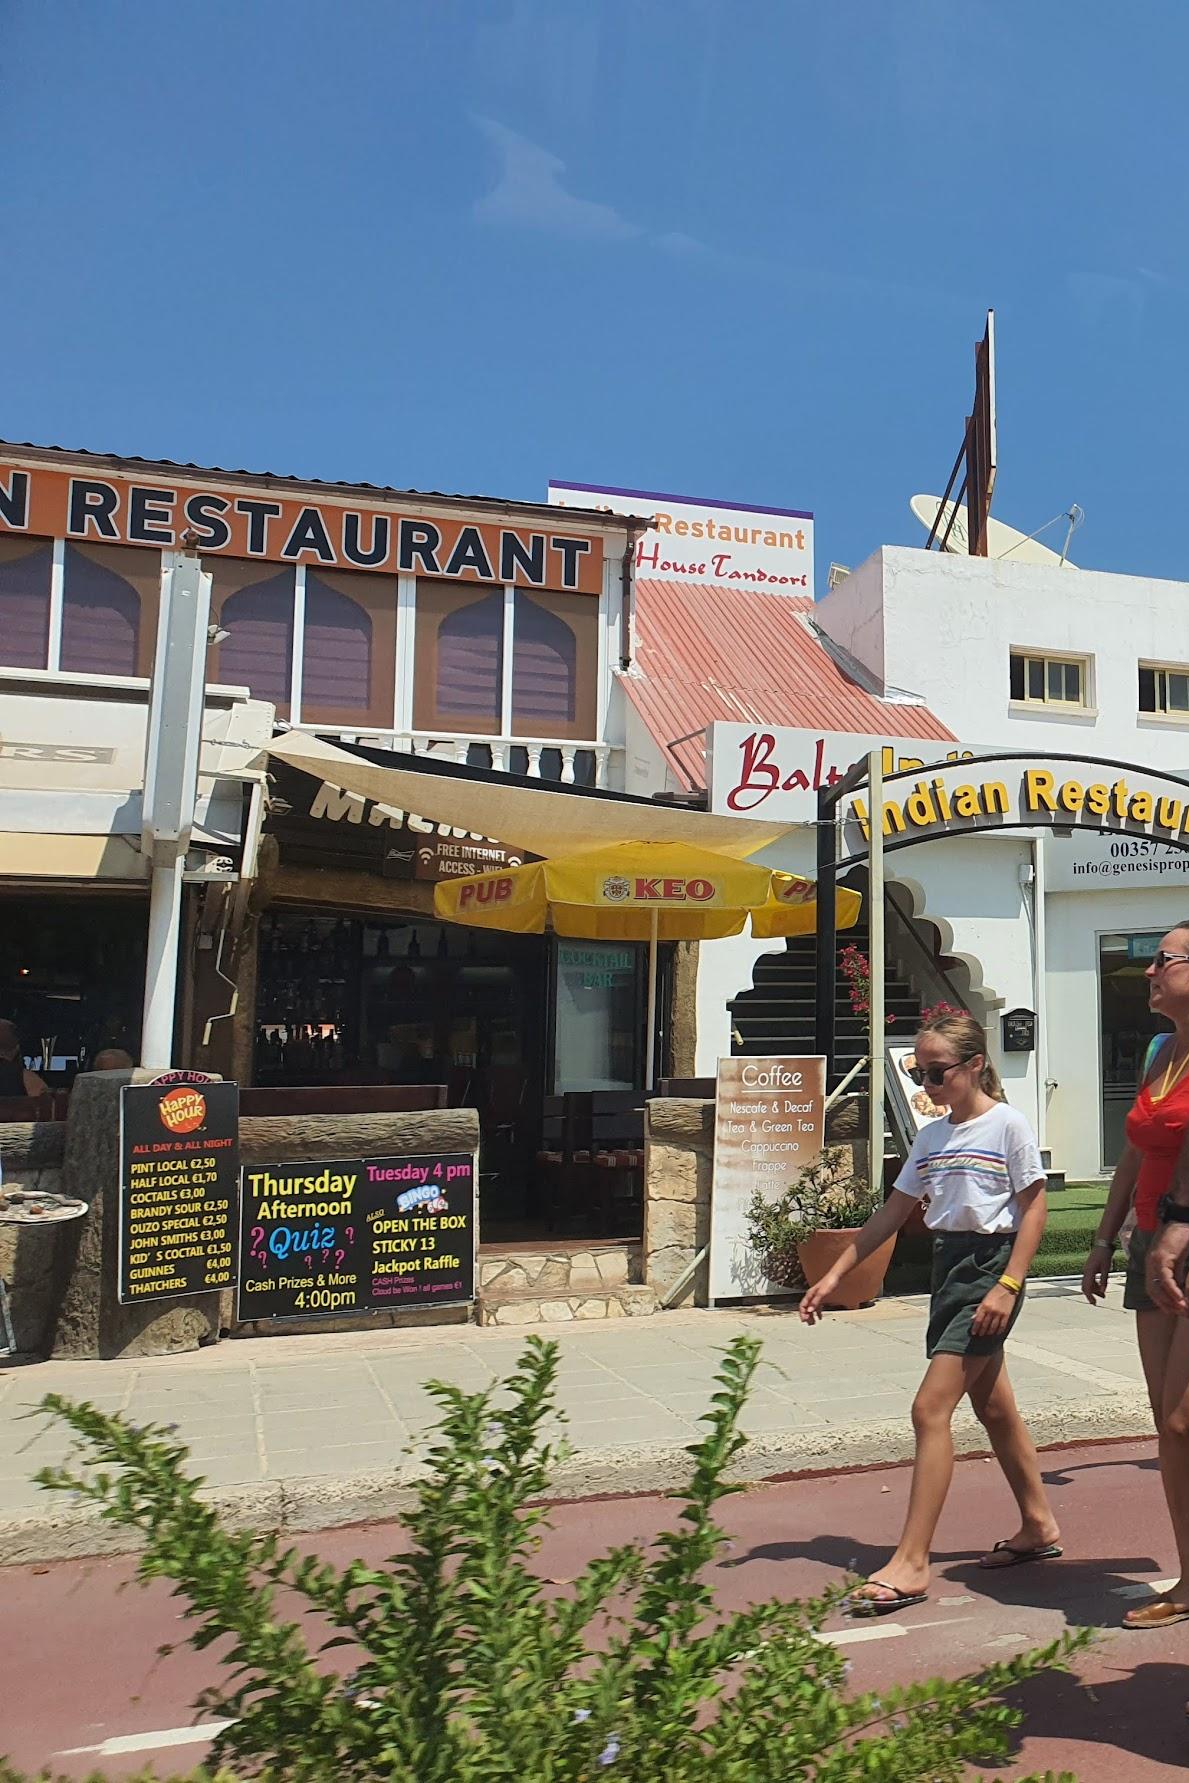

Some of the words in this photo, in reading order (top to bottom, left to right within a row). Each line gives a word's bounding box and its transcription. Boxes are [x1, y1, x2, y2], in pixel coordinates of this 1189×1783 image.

[67, 478, 592, 589] RESTAURANT
[655, 512, 805, 550] Restaurant
[636, 541, 705, 575] House
[712, 554, 807, 587] Tandoori
[727, 732, 858, 811] Balt
[851, 776, 1009, 843] Indian
[437, 843, 459, 858] FREE
[462, 846, 506, 862] INTERNET
[1110, 841, 1158, 857] 00357
[438, 860, 475, 875] ACCESS
[460, 877, 513, 907] PUB
[635, 878, 715, 901] KEO
[154, 1071, 184, 1085] APPY
[741, 1065, 803, 1087] Coffee
[730, 1101, 767, 1114] Nescafe
[772, 1101, 779, 1113] &
[785, 1100, 815, 1113] Decaf
[727, 1121, 745, 1133] Tea
[749, 1121, 757, 1133] &
[762, 1120, 793, 1133] Green
[797, 1120, 814, 1132] Tea
[133, 1145, 151, 1154] ALL
[153, 1143, 173, 1152] DAY
[174, 1143, 182, 1151] &
[185, 1141, 201, 1150] ALL
[203, 1138, 233, 1148] NIGHT
[741, 1140, 799, 1156] Cappuccino
[131, 1162, 155, 1174] PINT
[157, 1159, 188, 1171] LOCAL
[190, 1157, 216, 1169] €2,50
[367, 1164, 429, 1182] Tuesday
[433, 1163, 443, 1177] 4
[447, 1164, 471, 1182] pm
[752, 1159, 787, 1173] Frappe
[131, 1176, 157, 1189] HALF
[159, 1174, 190, 1187] LOCAL
[192, 1172, 217, 1184] €1,70
[248, 1169, 357, 1198] Thursday
[131, 1191, 177, 1204] COCTAILS
[180, 1188, 206, 1199] €3,00
[397, 1184, 440, 1205] BINGO
[131, 1206, 173, 1219] BRANDY
[175, 1203, 202, 1215] SOUR
[203, 1200, 228, 1212] €2,50
[257, 1200, 352, 1220] Afternoon
[366, 1209, 385, 1223] ALSO
[130, 1222, 160, 1234] OUZO
[162, 1218, 200, 1231] SPECIAL
[202, 1214, 227, 1227] €2,50
[372, 1218, 408, 1234] OPEN
[411, 1217, 438, 1232] THE
[440, 1215, 466, 1230] BOX
[130, 1237, 159, 1250] JOHN
[161, 1233, 198, 1246] SMITHS
[200, 1229, 225, 1241] €3,00
[269, 1222, 336, 1260] Quiz
[372, 1238, 417, 1254] STICKY
[421, 1237, 435, 1250] 13
[164, 1246, 205, 1260] COCTAIL
[207, 1243, 231, 1256] €1,50
[130, 1265, 175, 1279] GUINNES
[206, 1257, 231, 1269] €4,00
[372, 1258, 421, 1275] Jackpot
[424, 1254, 460, 1270] Raffle
[129, 1277, 187, 1294] THATCHERS
[205, 1273, 230, 1284] €4,00
[246, 1279, 275, 1292] Cash
[279, 1276, 313, 1289] Prizes
[317, 1275, 325, 1286] &
[328, 1273, 357, 1286] More
[372, 1277, 393, 1286] CASH
[294, 1289, 356, 1309] 4:00pm
